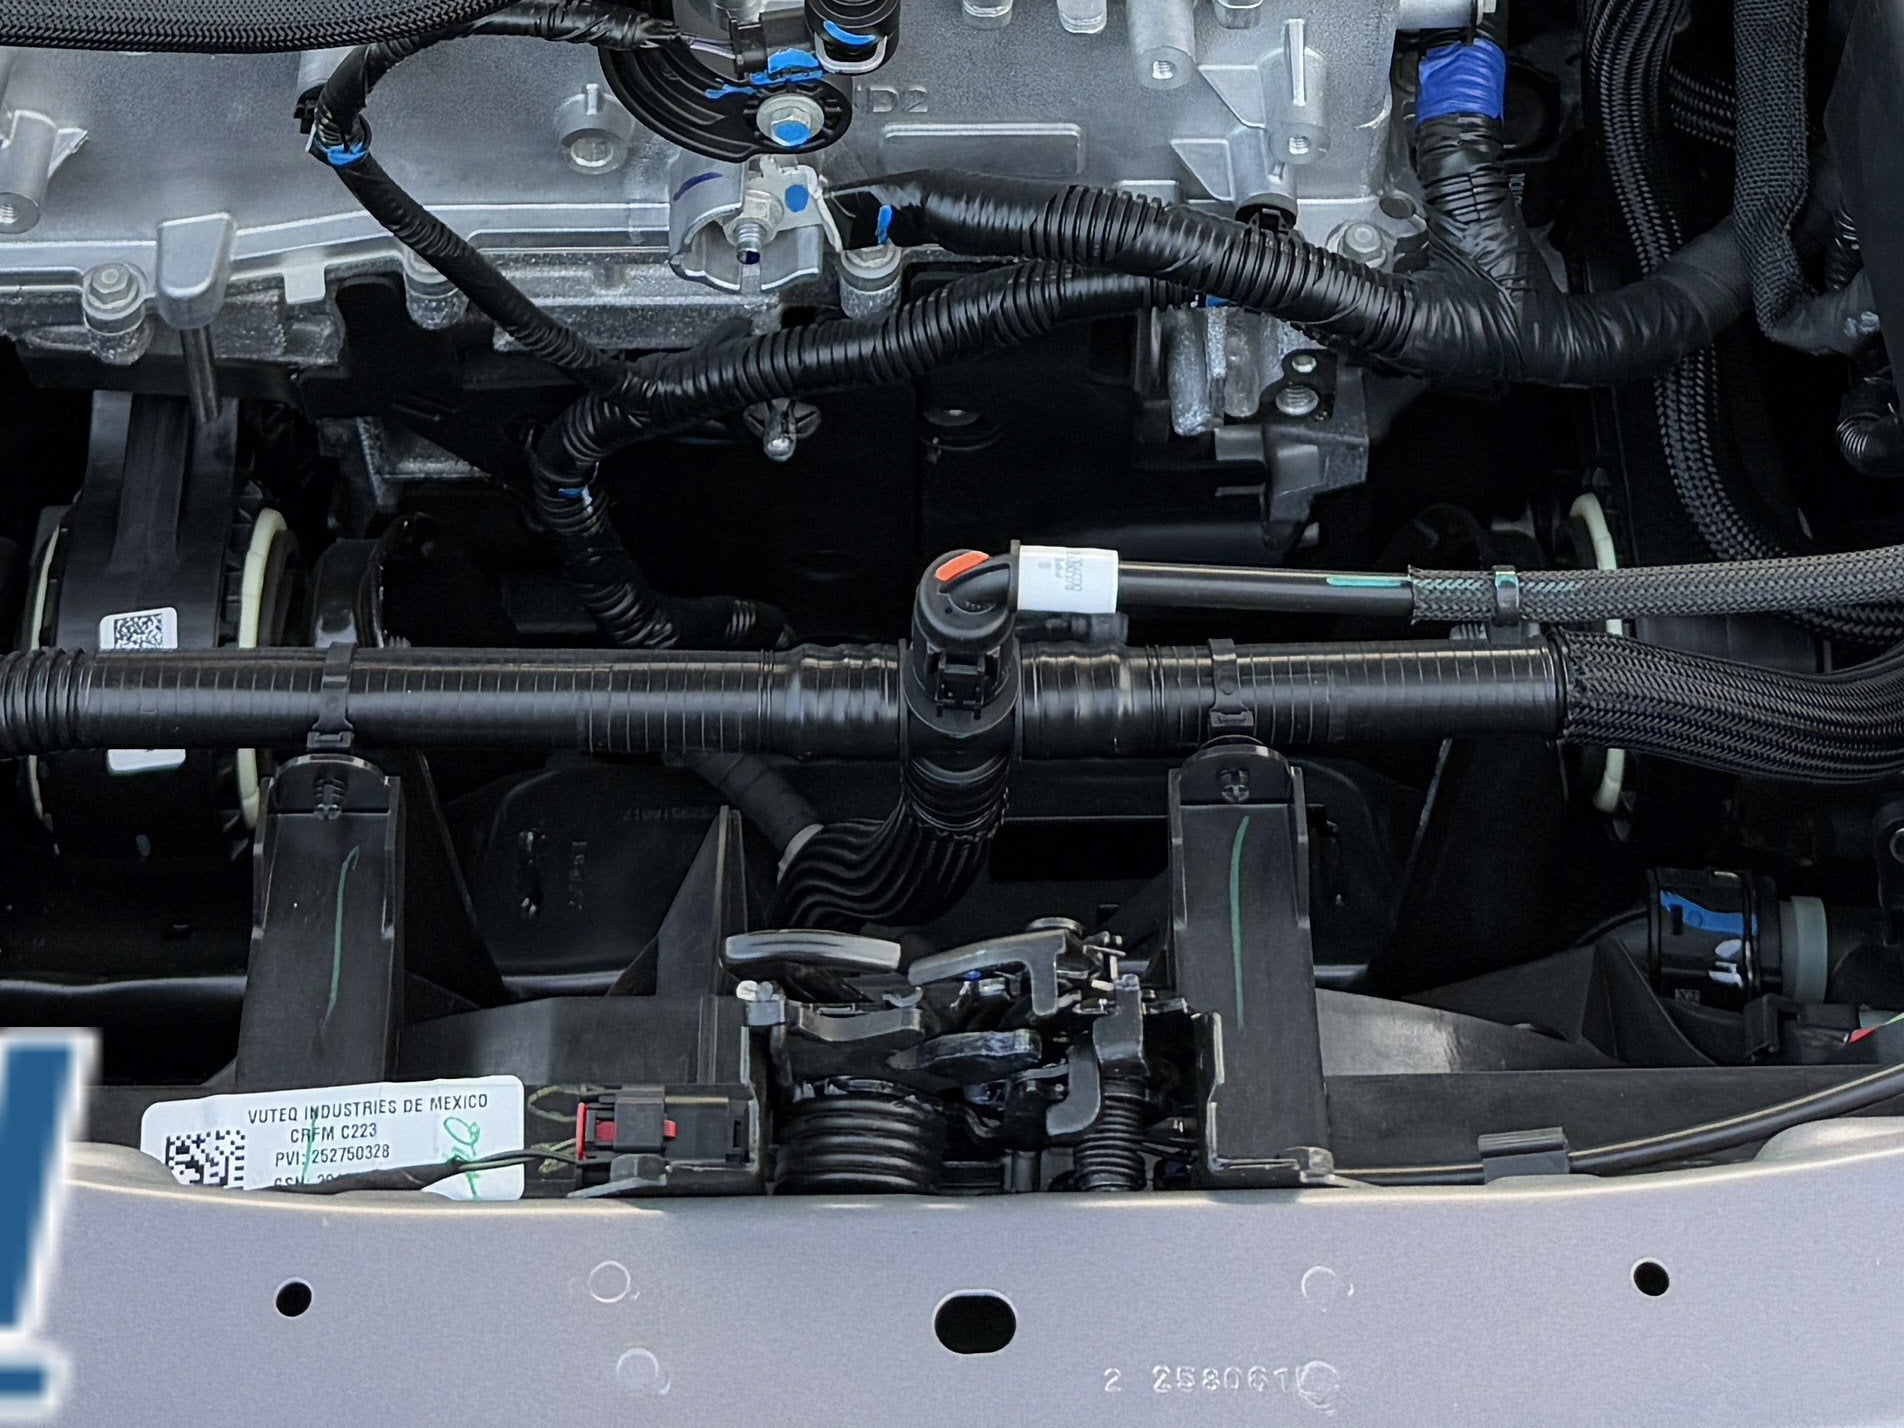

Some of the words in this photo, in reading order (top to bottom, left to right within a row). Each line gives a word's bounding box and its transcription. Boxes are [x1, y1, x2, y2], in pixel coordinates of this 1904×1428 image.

[248, 1107, 298, 1124] VUTEQ
[303, 1096, 398, 1121] INDUSTRIES
[403, 1097, 423, 1114] DE
[430, 1093, 488, 1112] MEXICO
[290, 1126, 335, 1144] CRFM
[341, 1122, 378, 1140] C223
[311, 1143, 391, 1164] 252750328
